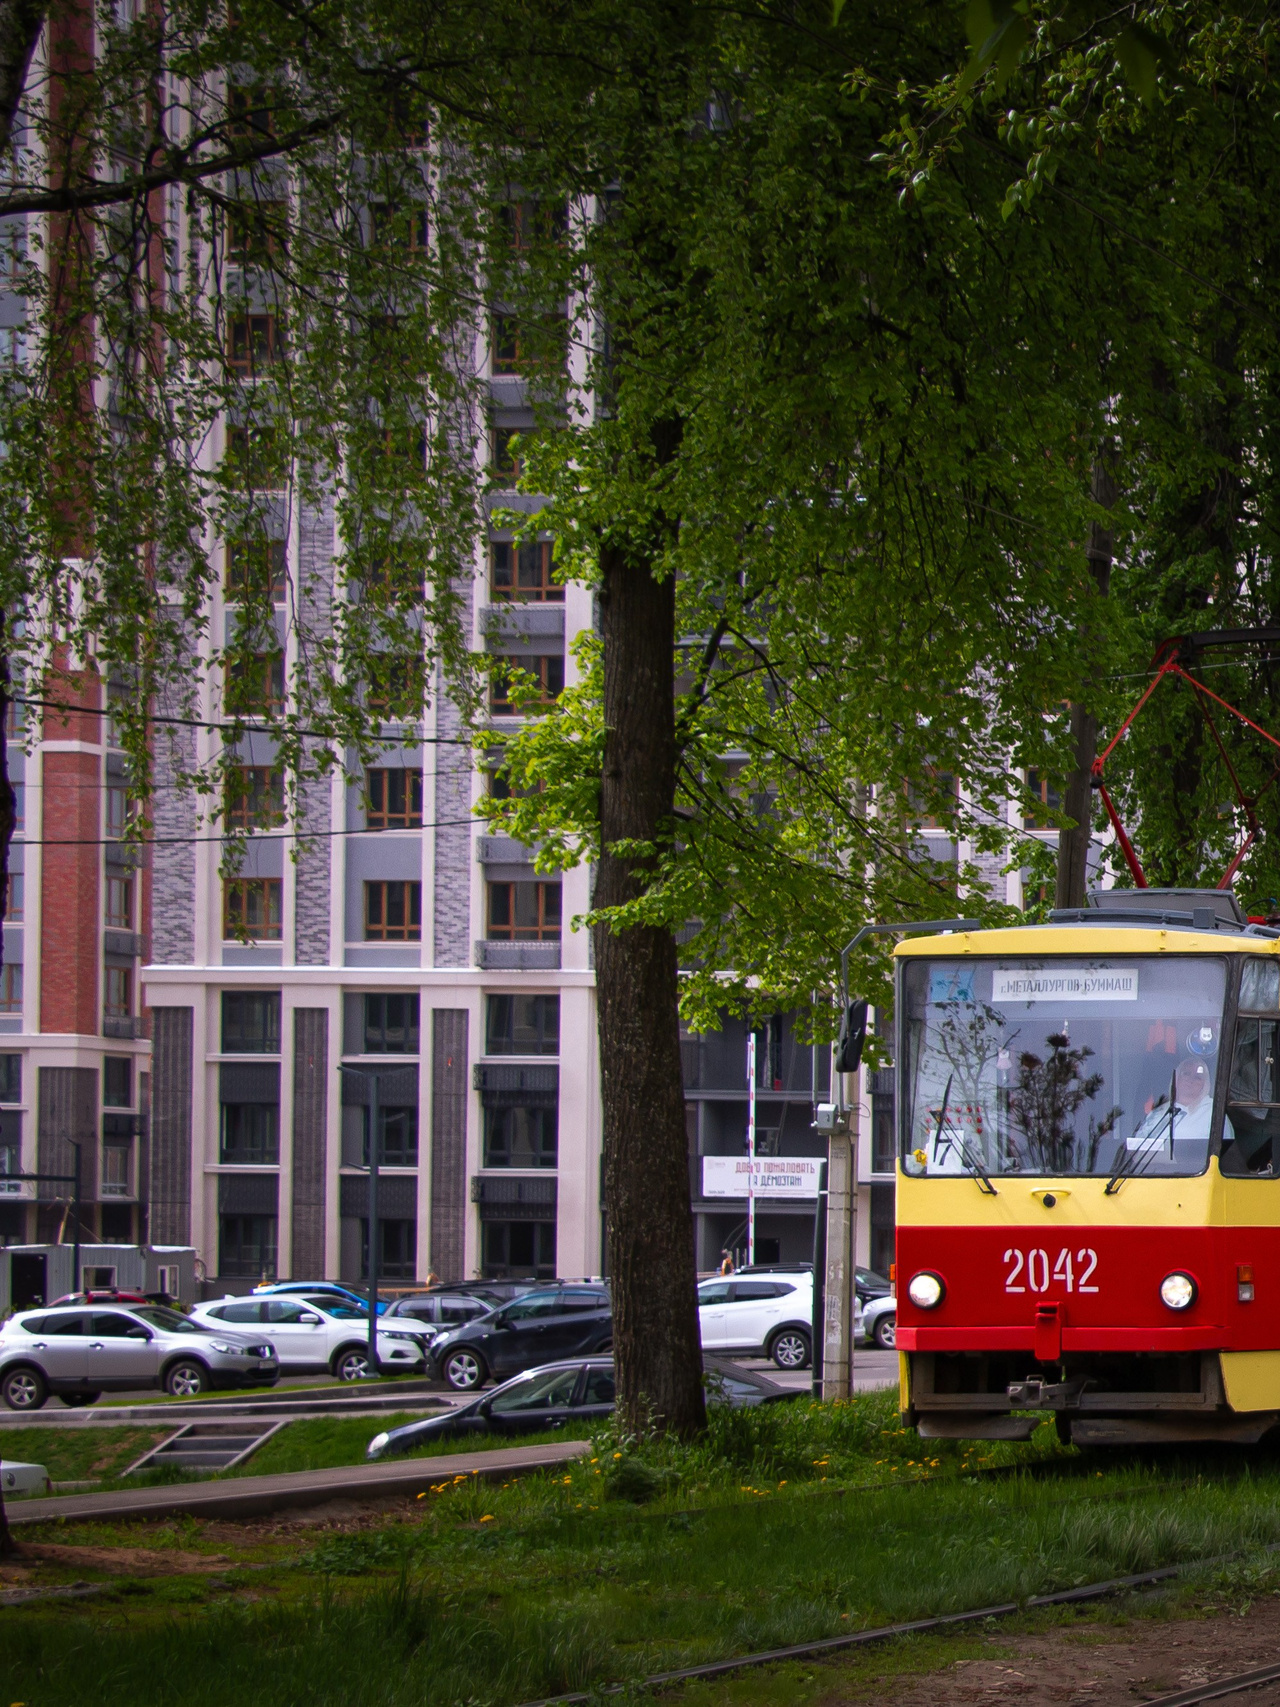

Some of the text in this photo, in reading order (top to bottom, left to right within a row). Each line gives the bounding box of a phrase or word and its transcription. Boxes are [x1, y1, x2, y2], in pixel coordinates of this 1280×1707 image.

[936, 1138, 953, 1166] 7
[735, 1161, 761, 1174] ДОБО
[764, 1161, 816, 1174] ПОЖАЛОВАТЬ
[1003, 1247, 1100, 1293] 2042
